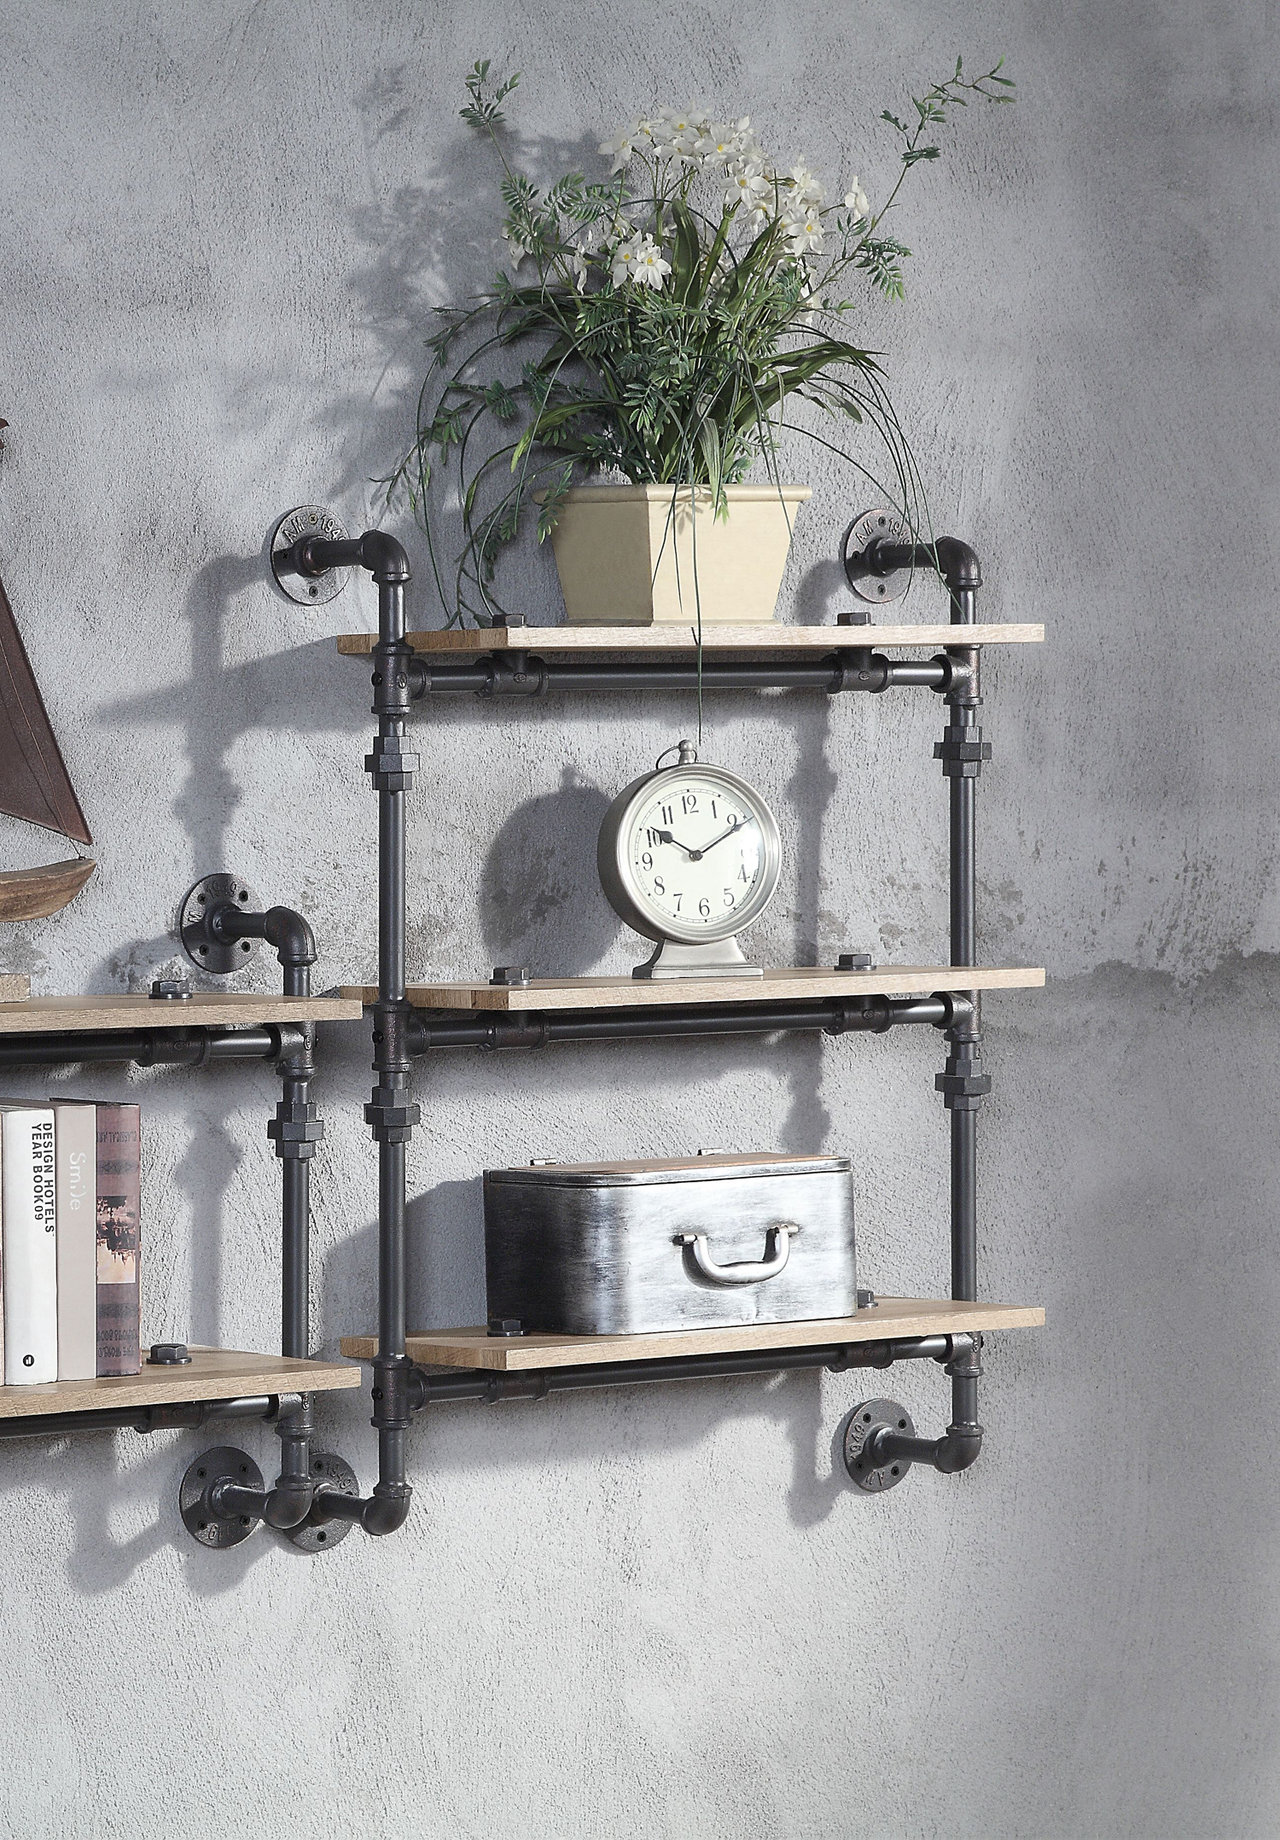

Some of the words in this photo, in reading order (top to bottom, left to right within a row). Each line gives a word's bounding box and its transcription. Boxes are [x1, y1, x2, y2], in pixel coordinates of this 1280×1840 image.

[682, 794, 699, 815] 12
[711, 800, 718, 819] 1
[662, 805, 674, 825] 11
[646, 829, 663, 848] 10
[641, 852, 653, 871] 9
[737, 863, 750, 883] 4
[653, 875, 665, 896] 8
[673, 893, 683, 912] 7
[698, 897, 710, 917] 6
[723, 887, 735, 907] 5
[31, 1123, 43, 1159] YEAR
[42, 1123, 54, 1173] DESIGN
